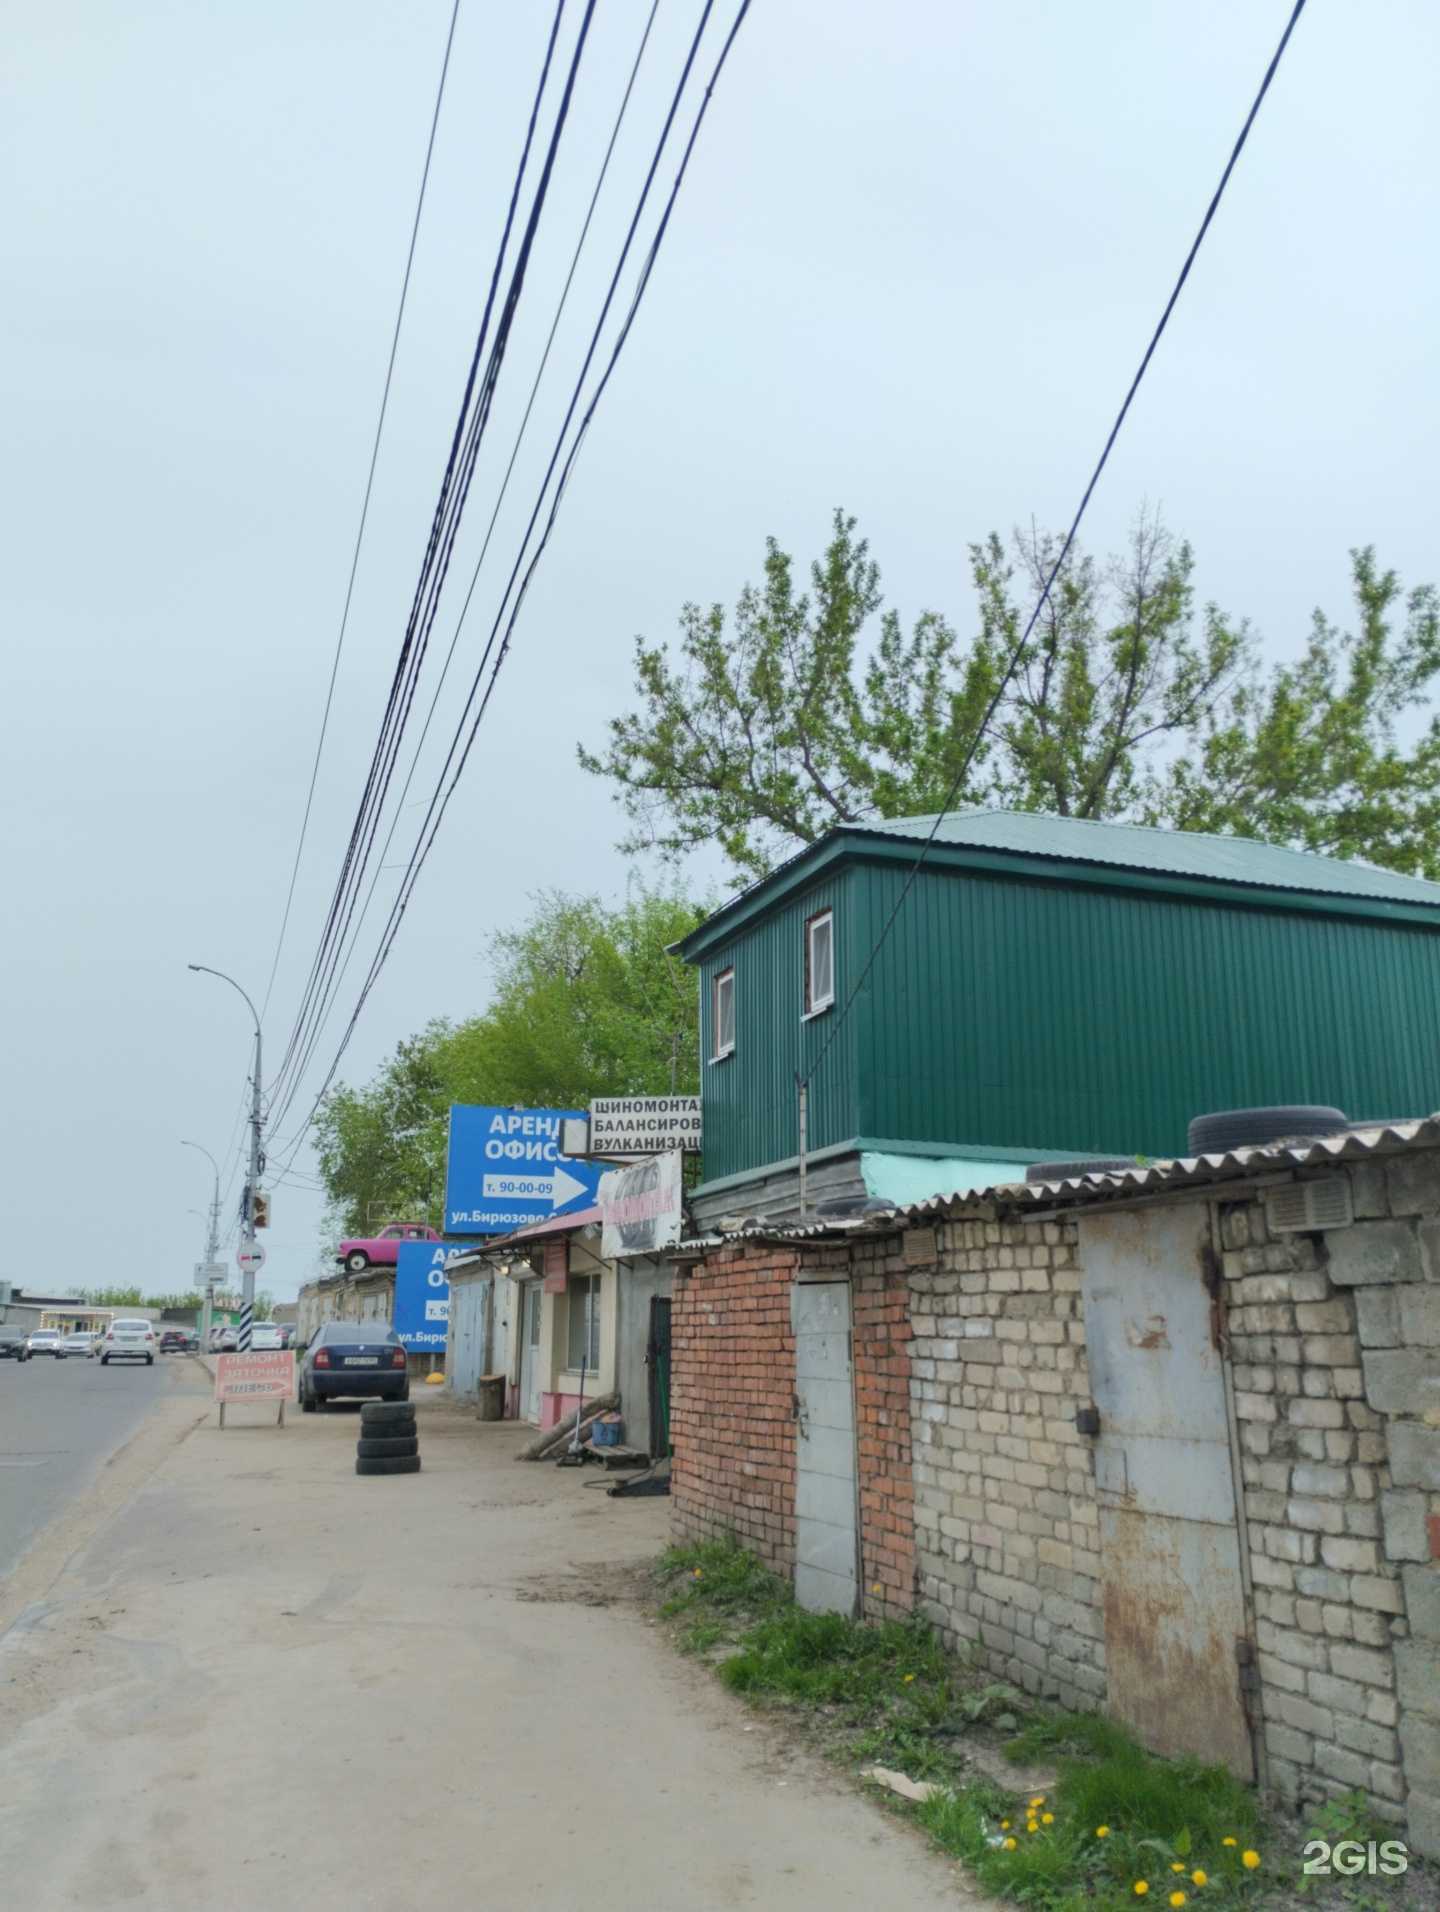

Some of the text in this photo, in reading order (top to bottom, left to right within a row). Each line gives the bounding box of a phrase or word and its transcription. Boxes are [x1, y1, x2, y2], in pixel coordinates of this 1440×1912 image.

[595, 1099, 701, 1114] ШИНОМОНТА
[489, 1114, 580, 1140] АРЕН
[595, 1118, 701, 1132] БАЛАНСИРОВ
[485, 1139, 586, 1162] ОФИС
[594, 1136, 701, 1151] ВУЛКАНИЗАЦ
[487, 1182, 553, 1194] т. 90-00-09
